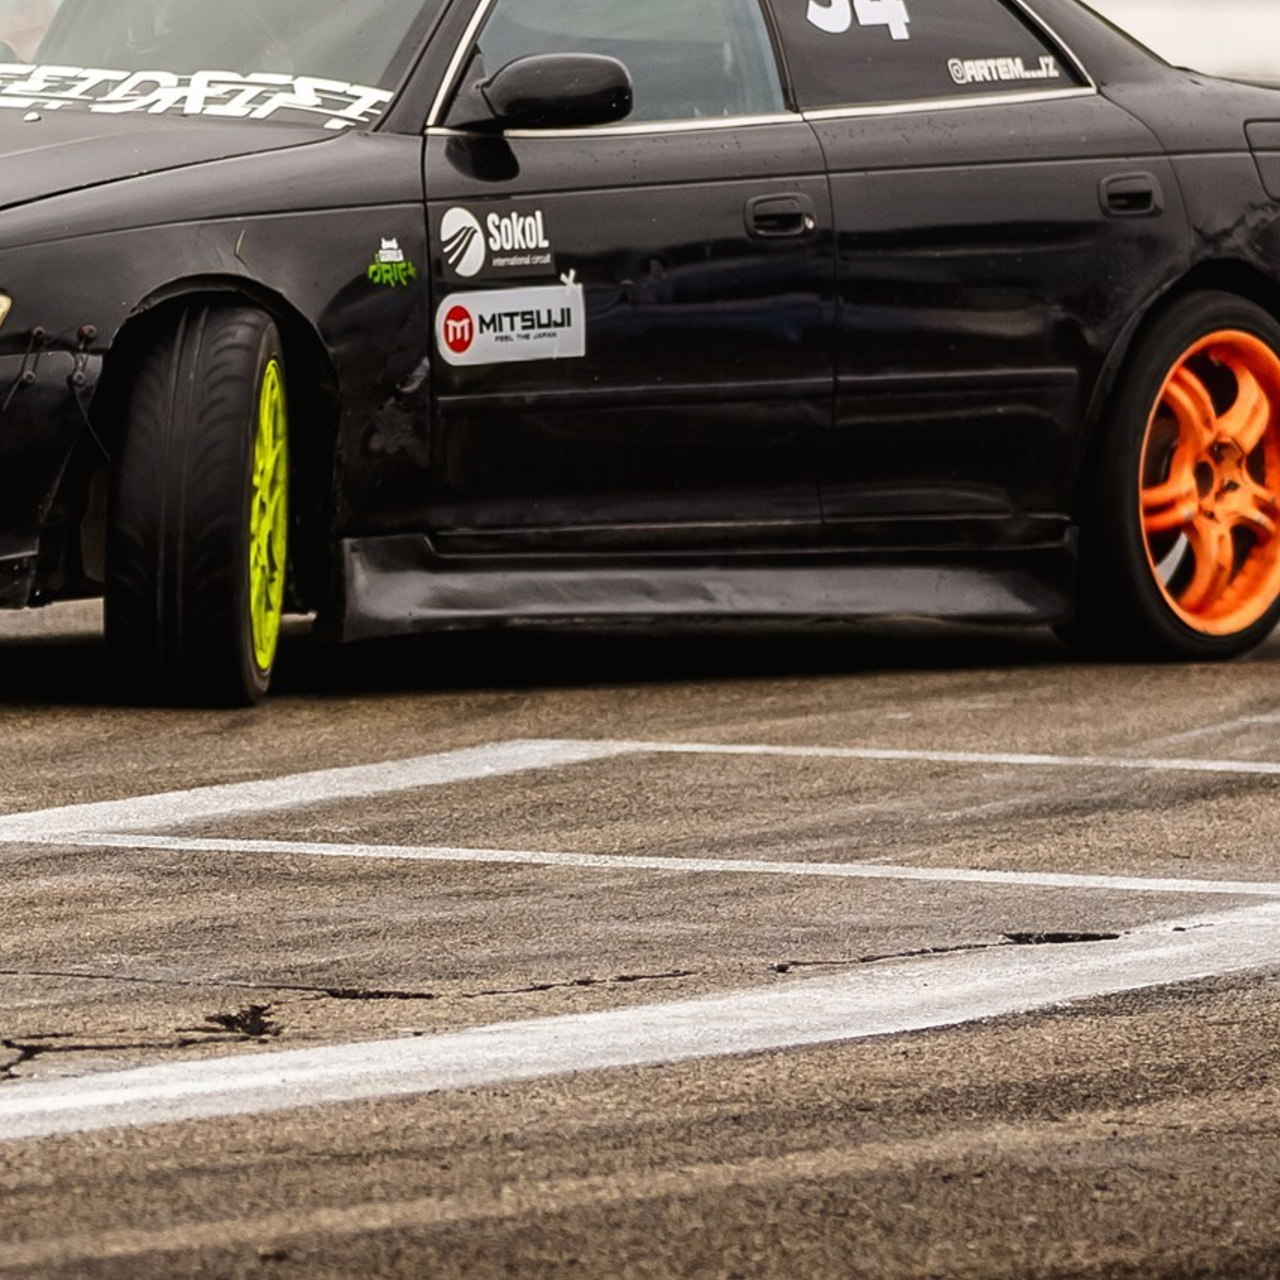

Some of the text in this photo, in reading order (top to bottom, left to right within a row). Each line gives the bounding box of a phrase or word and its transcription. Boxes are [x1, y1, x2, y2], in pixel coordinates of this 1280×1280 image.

[478, 307, 572, 334] MITSUJI
[494, 331, 558, 343] FEEL THE JAPAN
